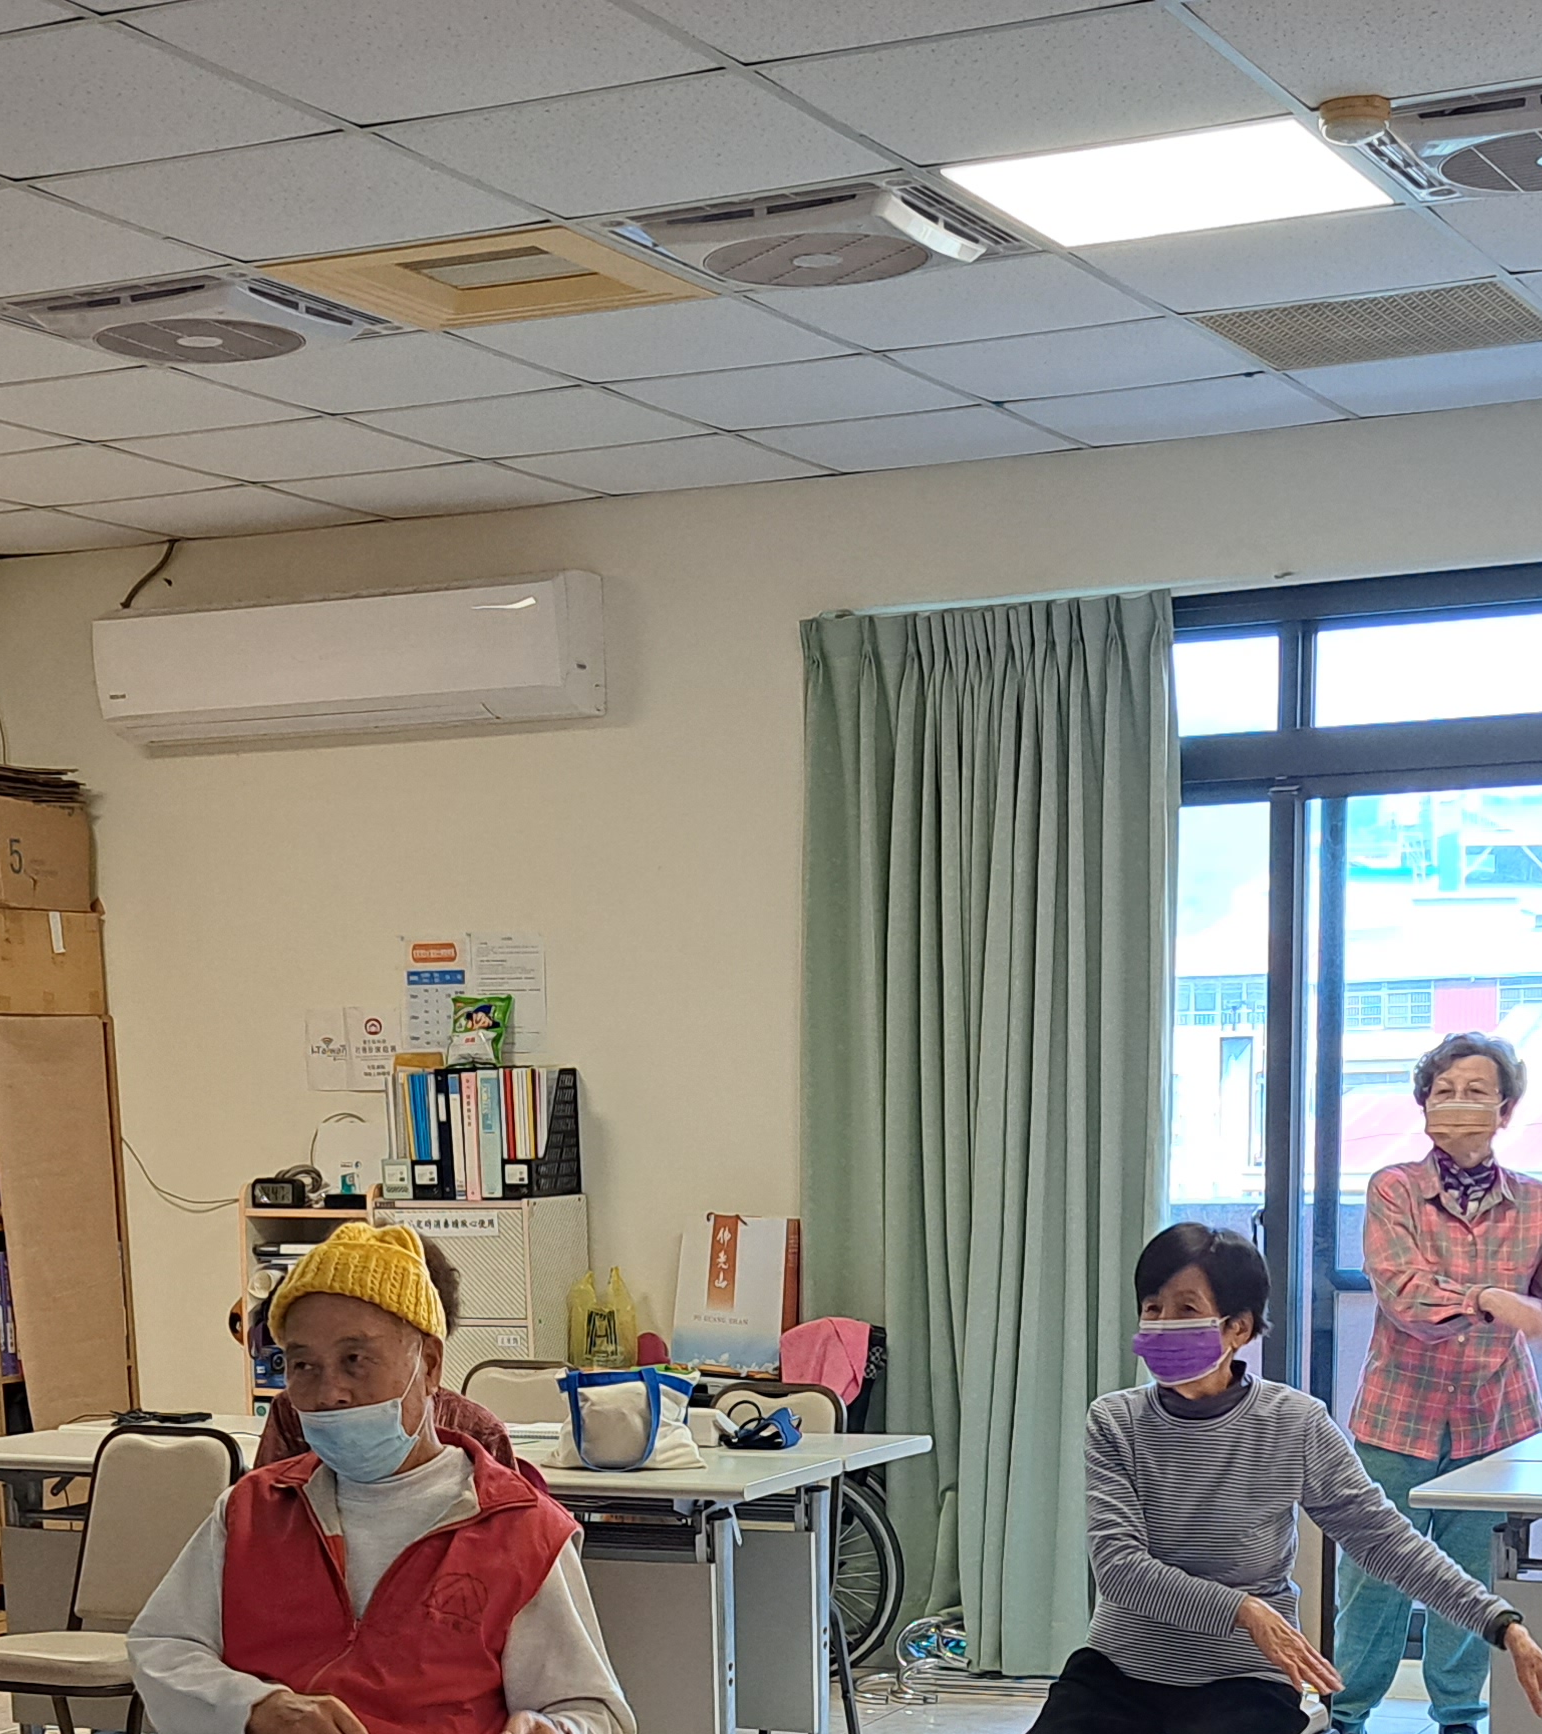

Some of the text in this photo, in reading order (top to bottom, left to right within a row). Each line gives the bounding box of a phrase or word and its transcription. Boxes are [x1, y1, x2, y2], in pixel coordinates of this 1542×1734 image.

[9, 838, 23, 875] 5
[715, 1225, 732, 1289] 佛光山
